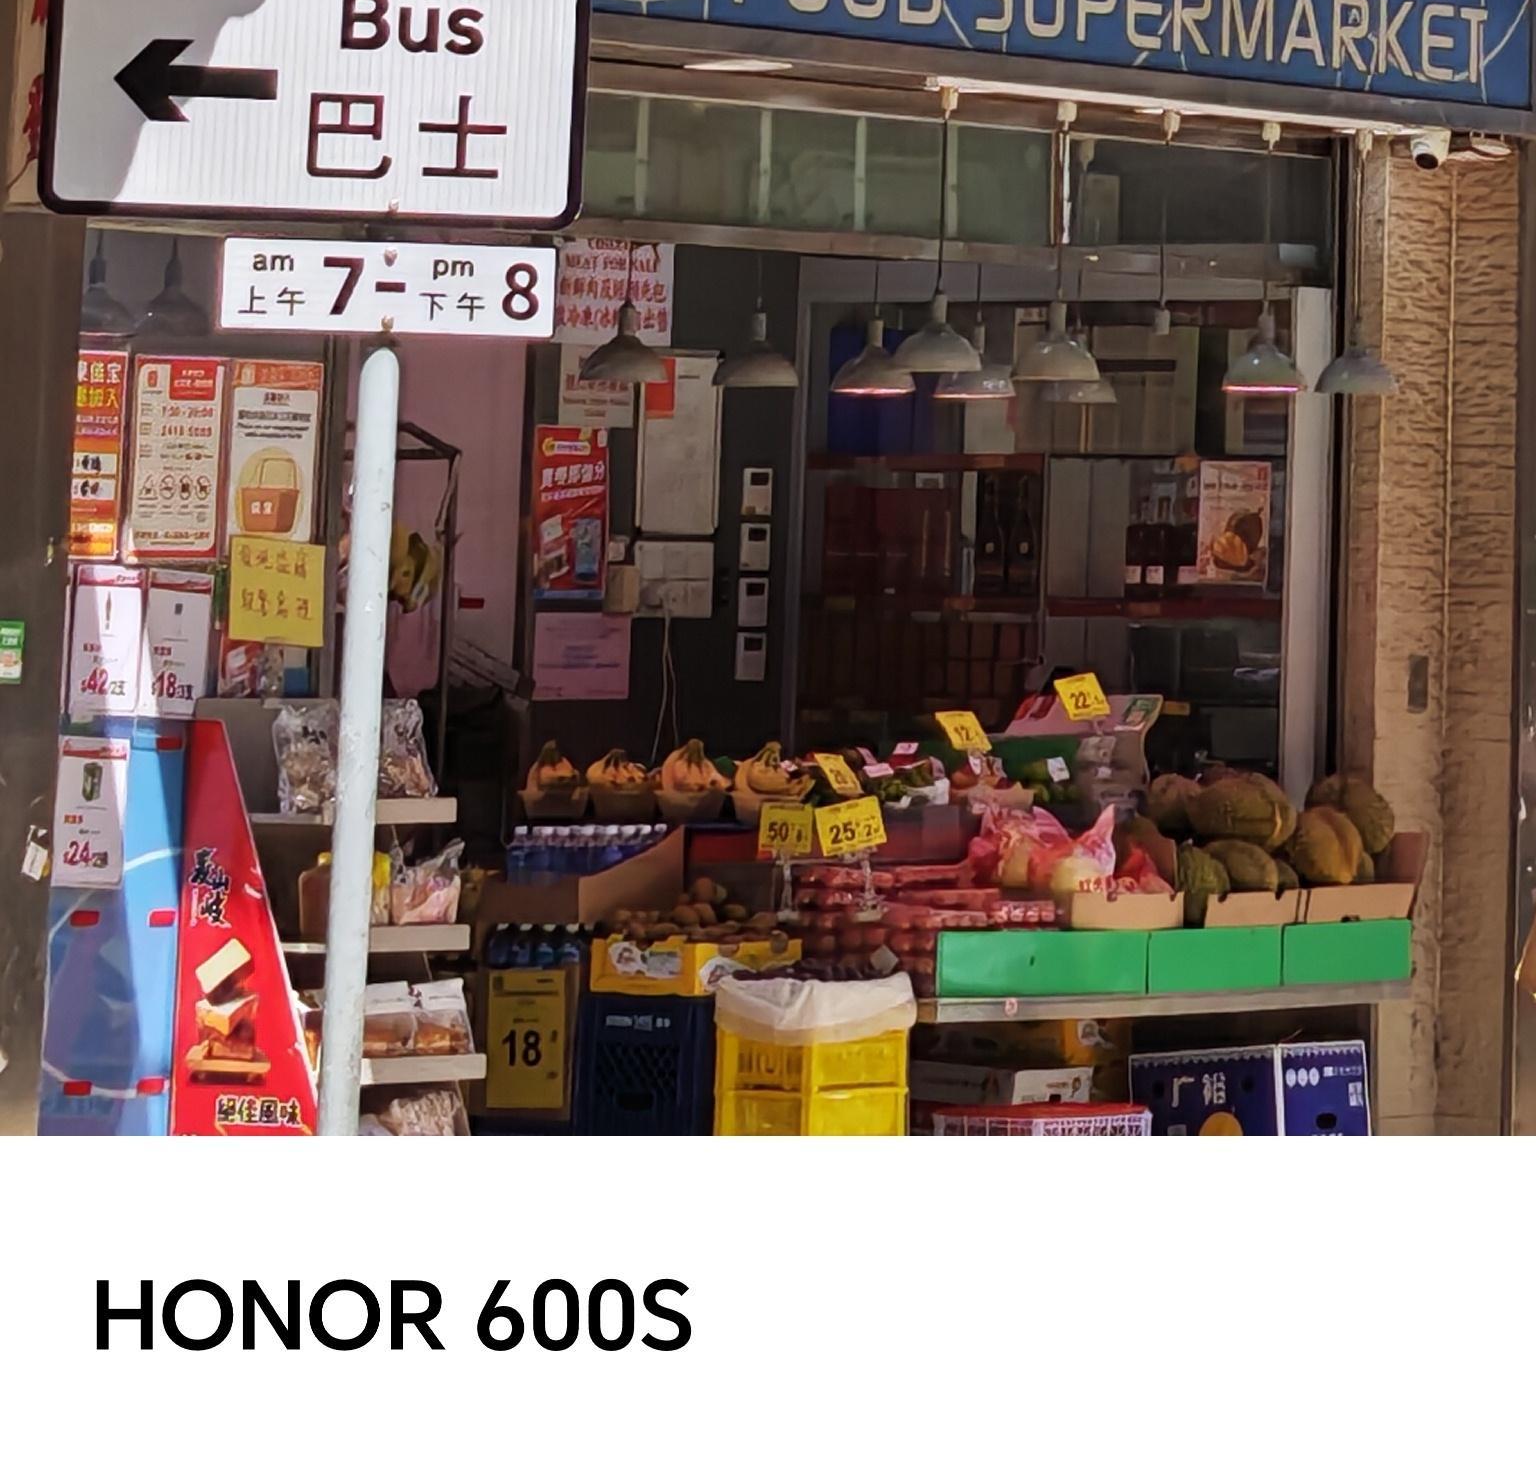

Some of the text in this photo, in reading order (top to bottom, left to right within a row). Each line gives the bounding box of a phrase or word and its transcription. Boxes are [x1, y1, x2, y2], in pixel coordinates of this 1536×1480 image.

[305, 92, 509, 181] 巴士
[238, 285, 486, 323] 上午 下午
[252, 251, 295, 272] am
[432, 255, 476, 279] pm
[501, 261, 541, 321] 8
[501, 1029, 543, 1067] 18
